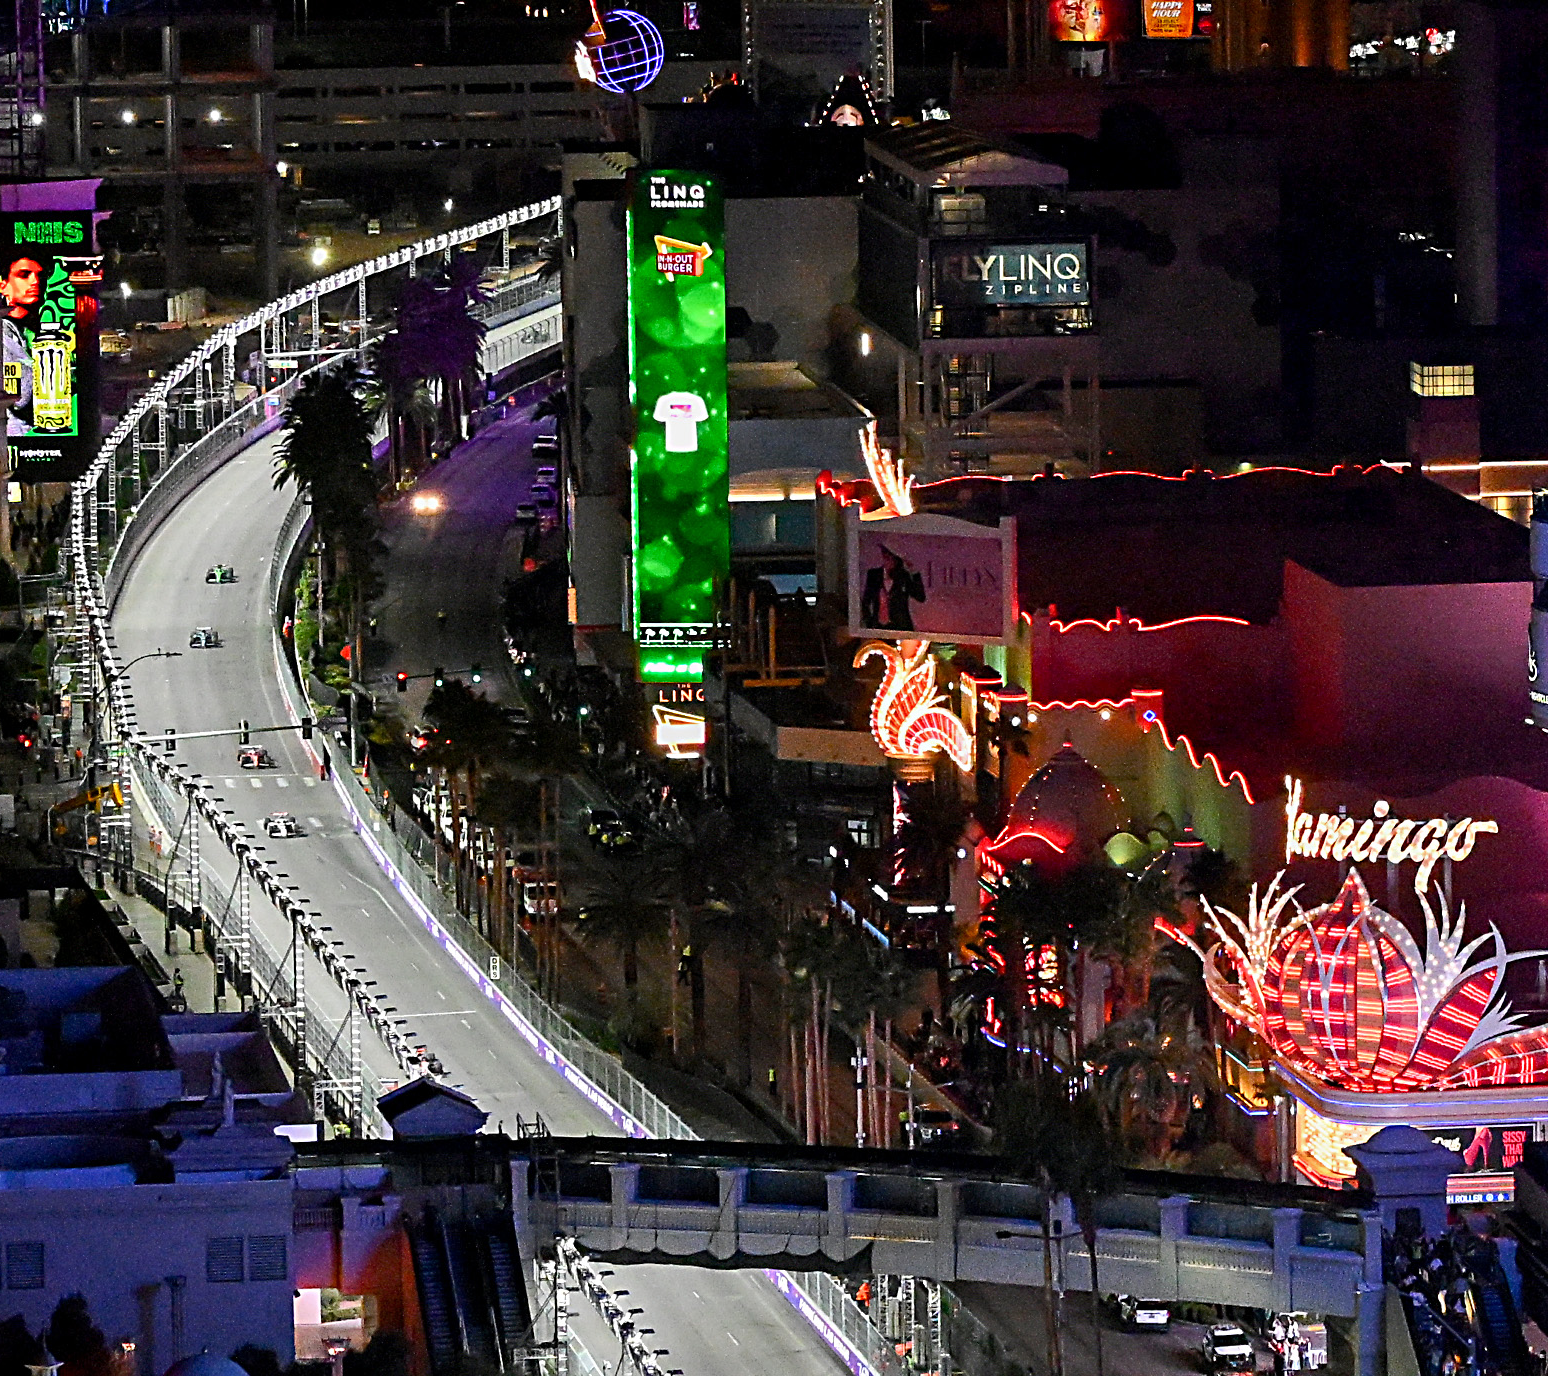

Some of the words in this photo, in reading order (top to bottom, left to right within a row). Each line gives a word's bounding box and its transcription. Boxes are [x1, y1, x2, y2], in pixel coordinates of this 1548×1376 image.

[1151, 1, 1184, 11] HAPPY
[1153, 10, 1181, 19] HOUR
[650, 186, 706, 200] LINQ
[650, 200, 706, 209] PROMENADE
[656, 253, 694, 266] IN-N-OUT
[656, 263, 694, 275] BURGER
[985, 283, 1081, 296] ZIPLINE
[4, 365, 17, 377] RO
[491, 957, 499, 979] DRS
[1502, 1130, 1526, 1143] SISSY
[1504, 1143, 1525, 1155] THAT
[1455, 1193, 1482, 1204] ROLLER
